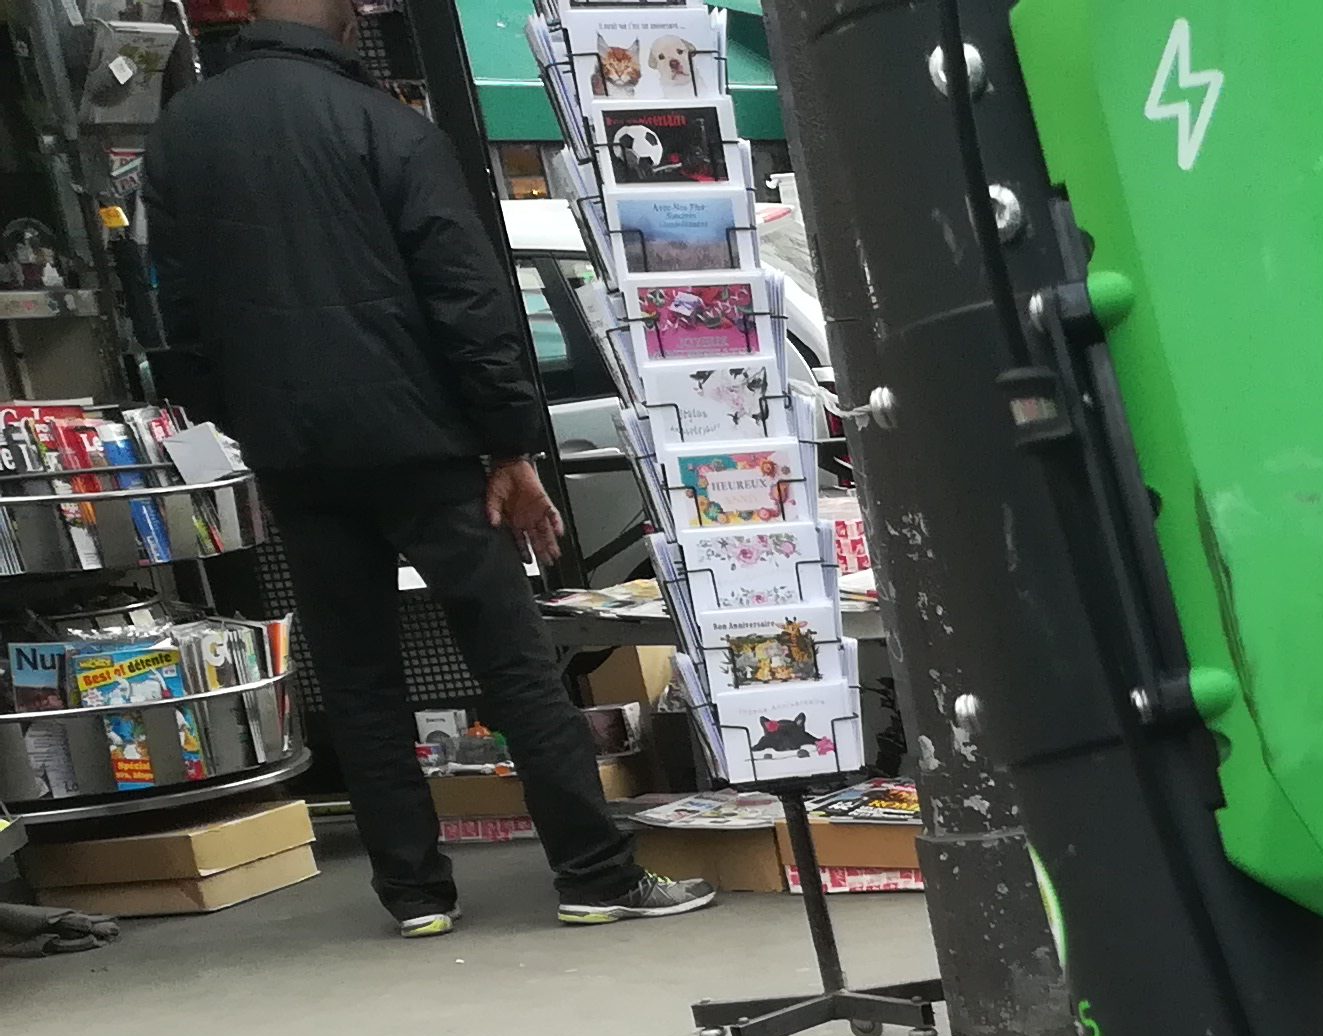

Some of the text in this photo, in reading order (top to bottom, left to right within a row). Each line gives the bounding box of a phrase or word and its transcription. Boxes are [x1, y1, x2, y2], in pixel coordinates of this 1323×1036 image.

[711, 479, 768, 492] HEUREUX
[713, 620, 776, 631] Bon Anniversaire
[82, 671, 112, 687] Best
[127, 652, 173, 674] détente
